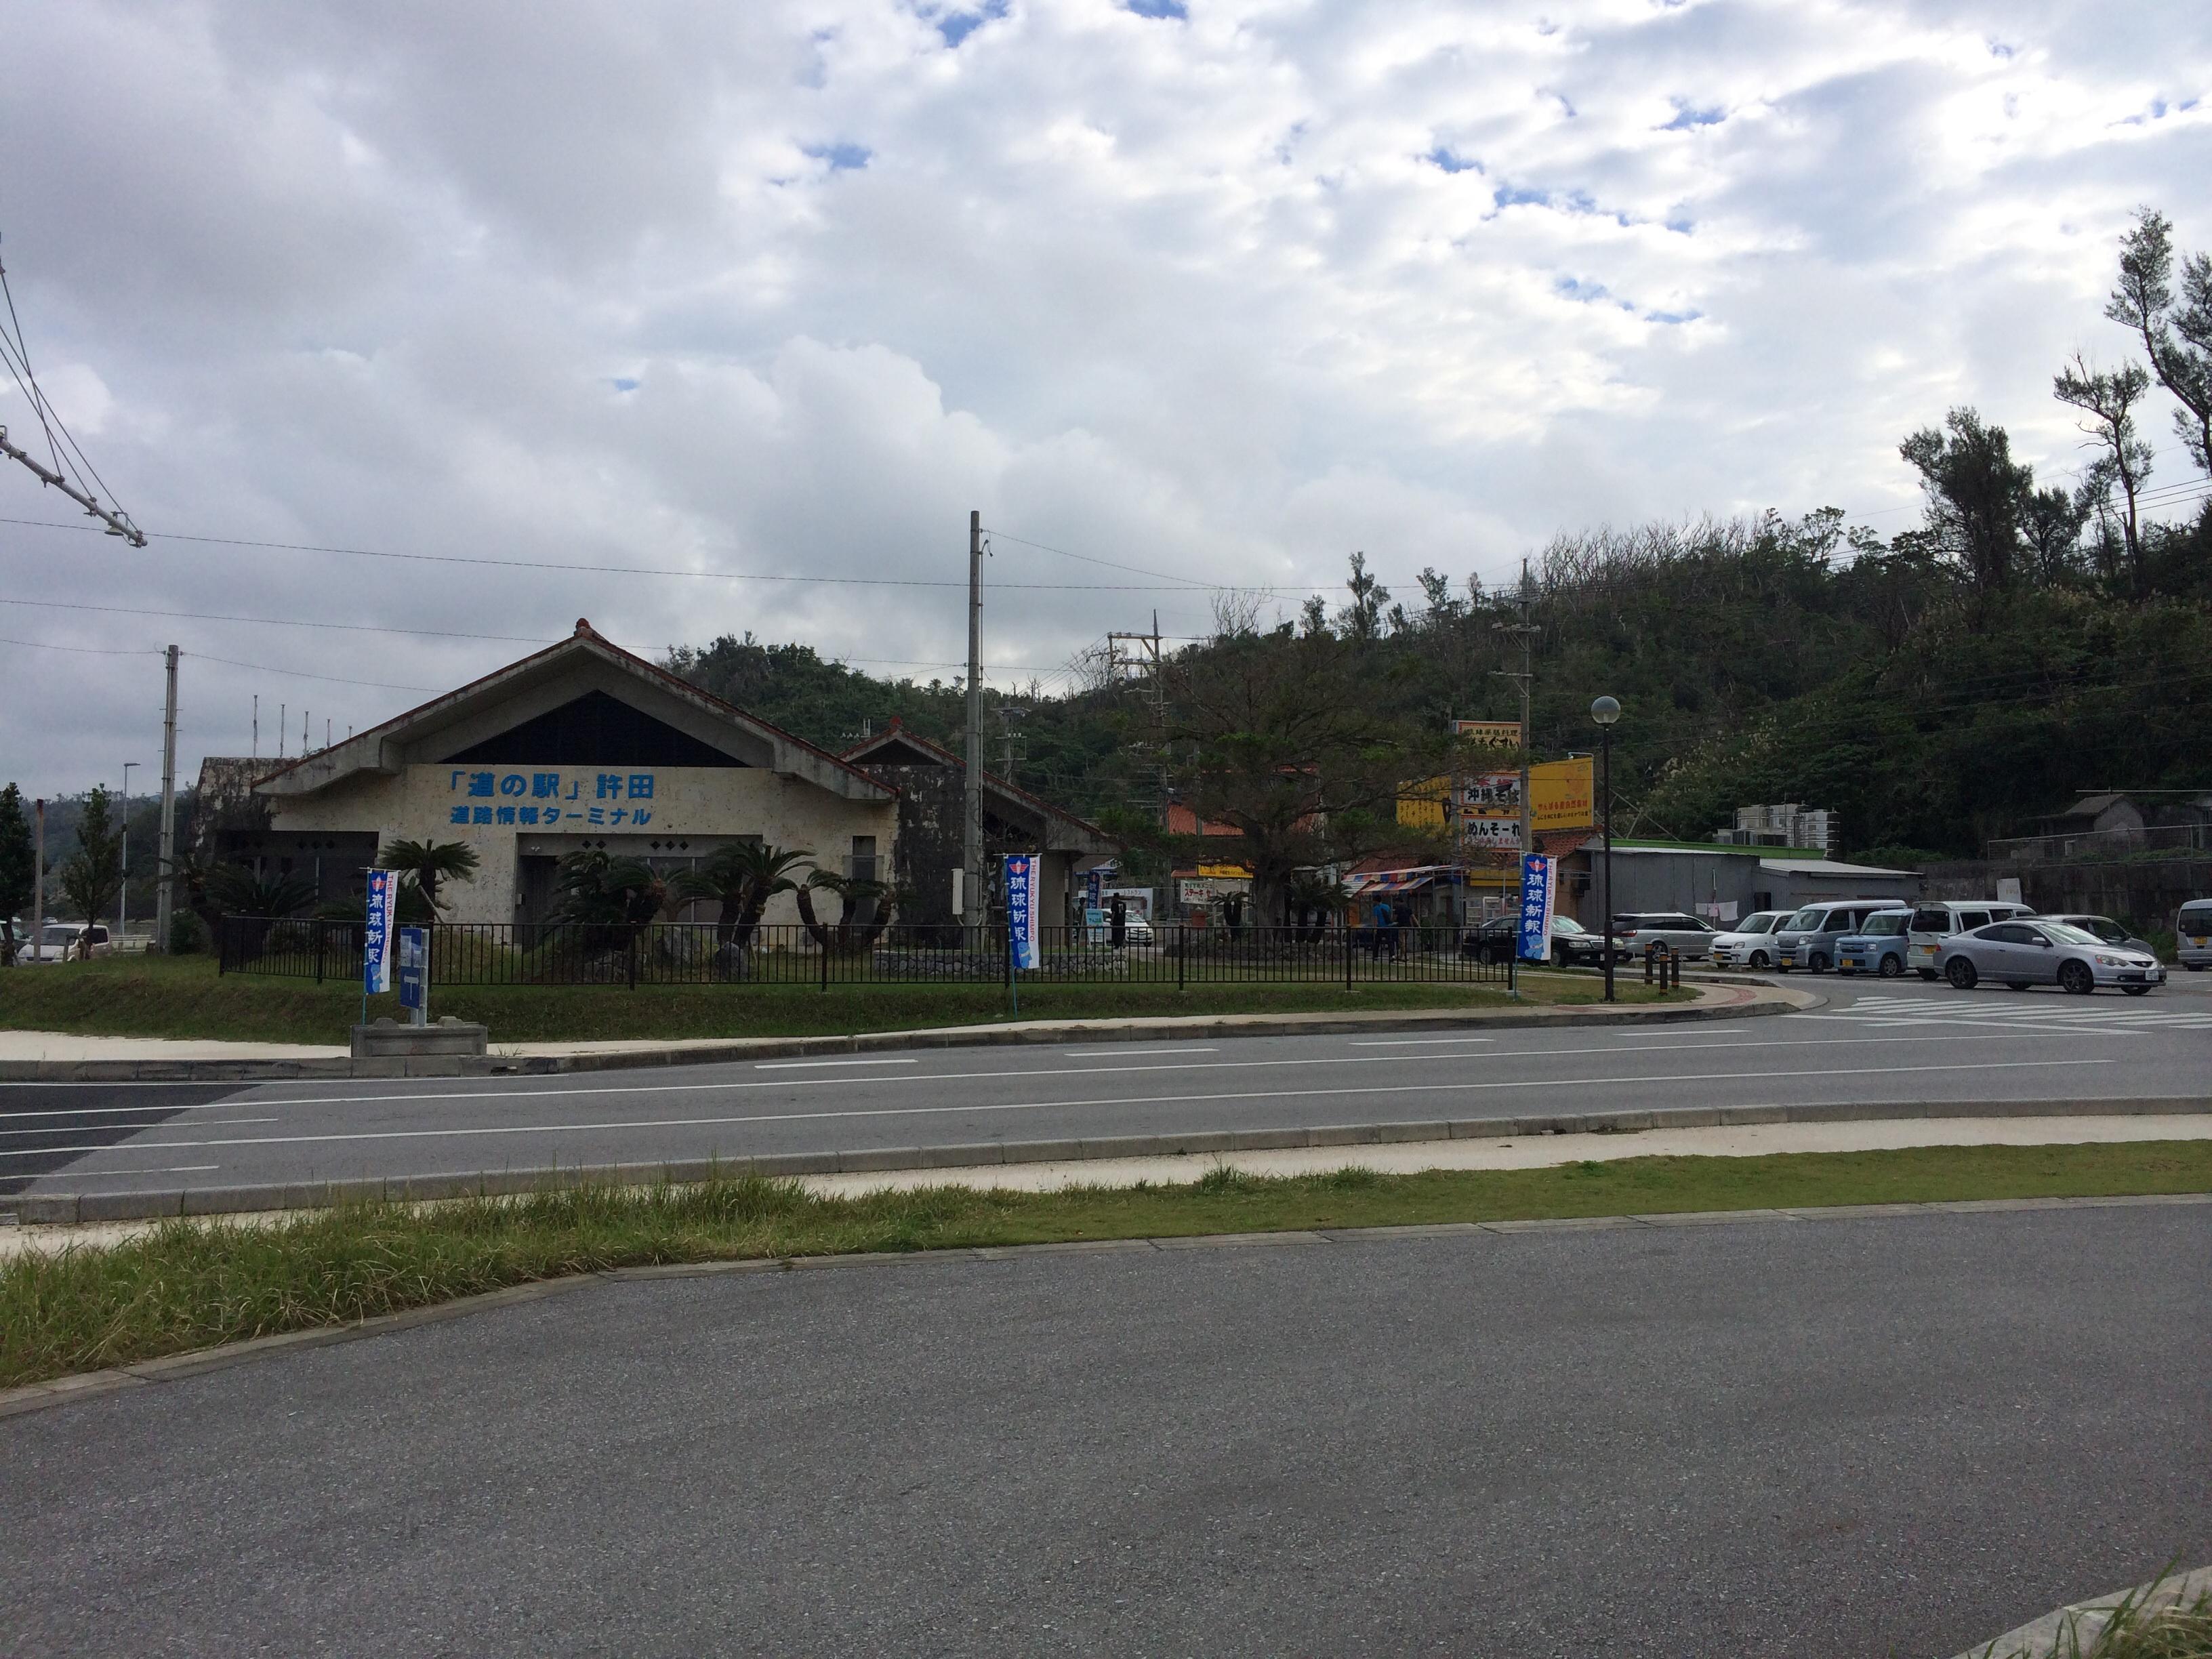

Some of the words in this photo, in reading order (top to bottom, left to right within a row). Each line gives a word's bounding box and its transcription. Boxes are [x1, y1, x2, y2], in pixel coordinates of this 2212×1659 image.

[451, 771, 655, 800] 「道の駅」許田
[450, 806, 652, 825] 道路情報ターミナル
[1468, 822, 1520, 836] めんそーれ
[1185, 889, 1204, 897] ステーキ
[1525, 874, 1545, 934] 琉球新報
